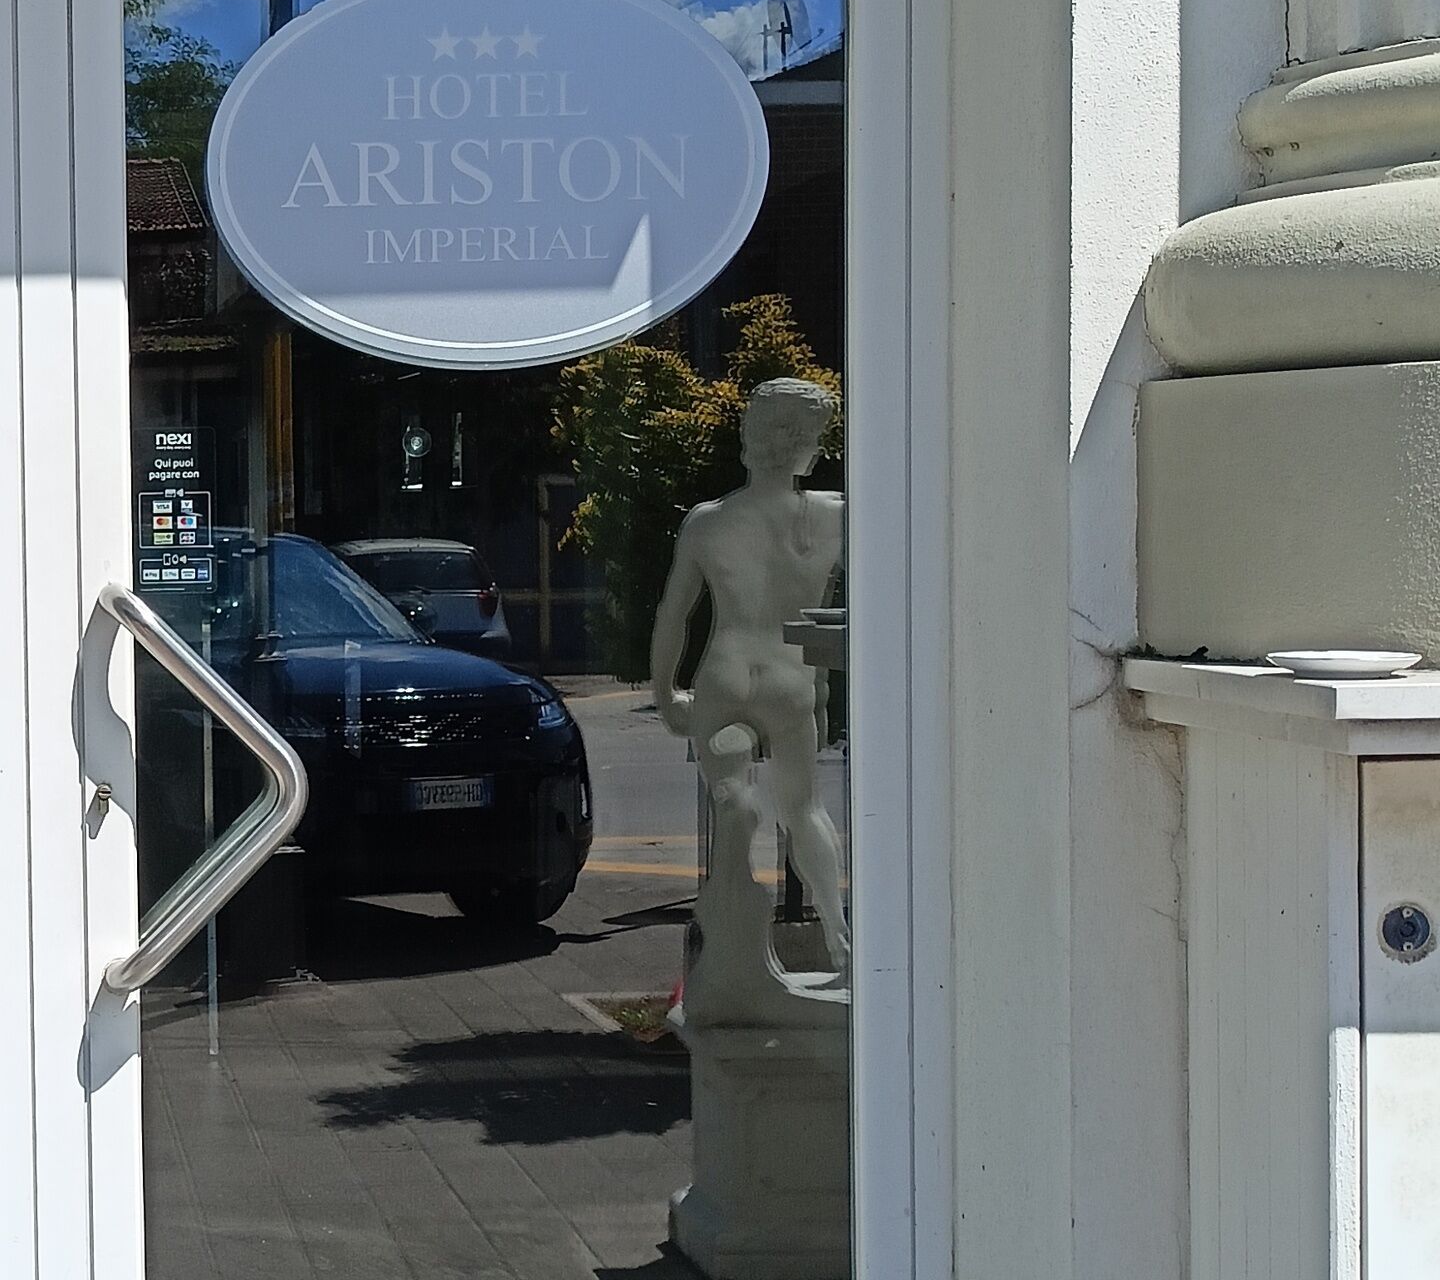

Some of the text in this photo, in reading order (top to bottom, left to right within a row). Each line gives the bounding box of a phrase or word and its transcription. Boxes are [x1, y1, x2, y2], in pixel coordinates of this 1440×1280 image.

[383, 70, 589, 120] HOTEL
[280, 133, 693, 209] ARISTON
[365, 224, 610, 265] IMPERIAL
[155, 433, 192, 446] nexi
[148, 470, 200, 482] pagare con
[154, 456, 194, 470] Qui puoi
